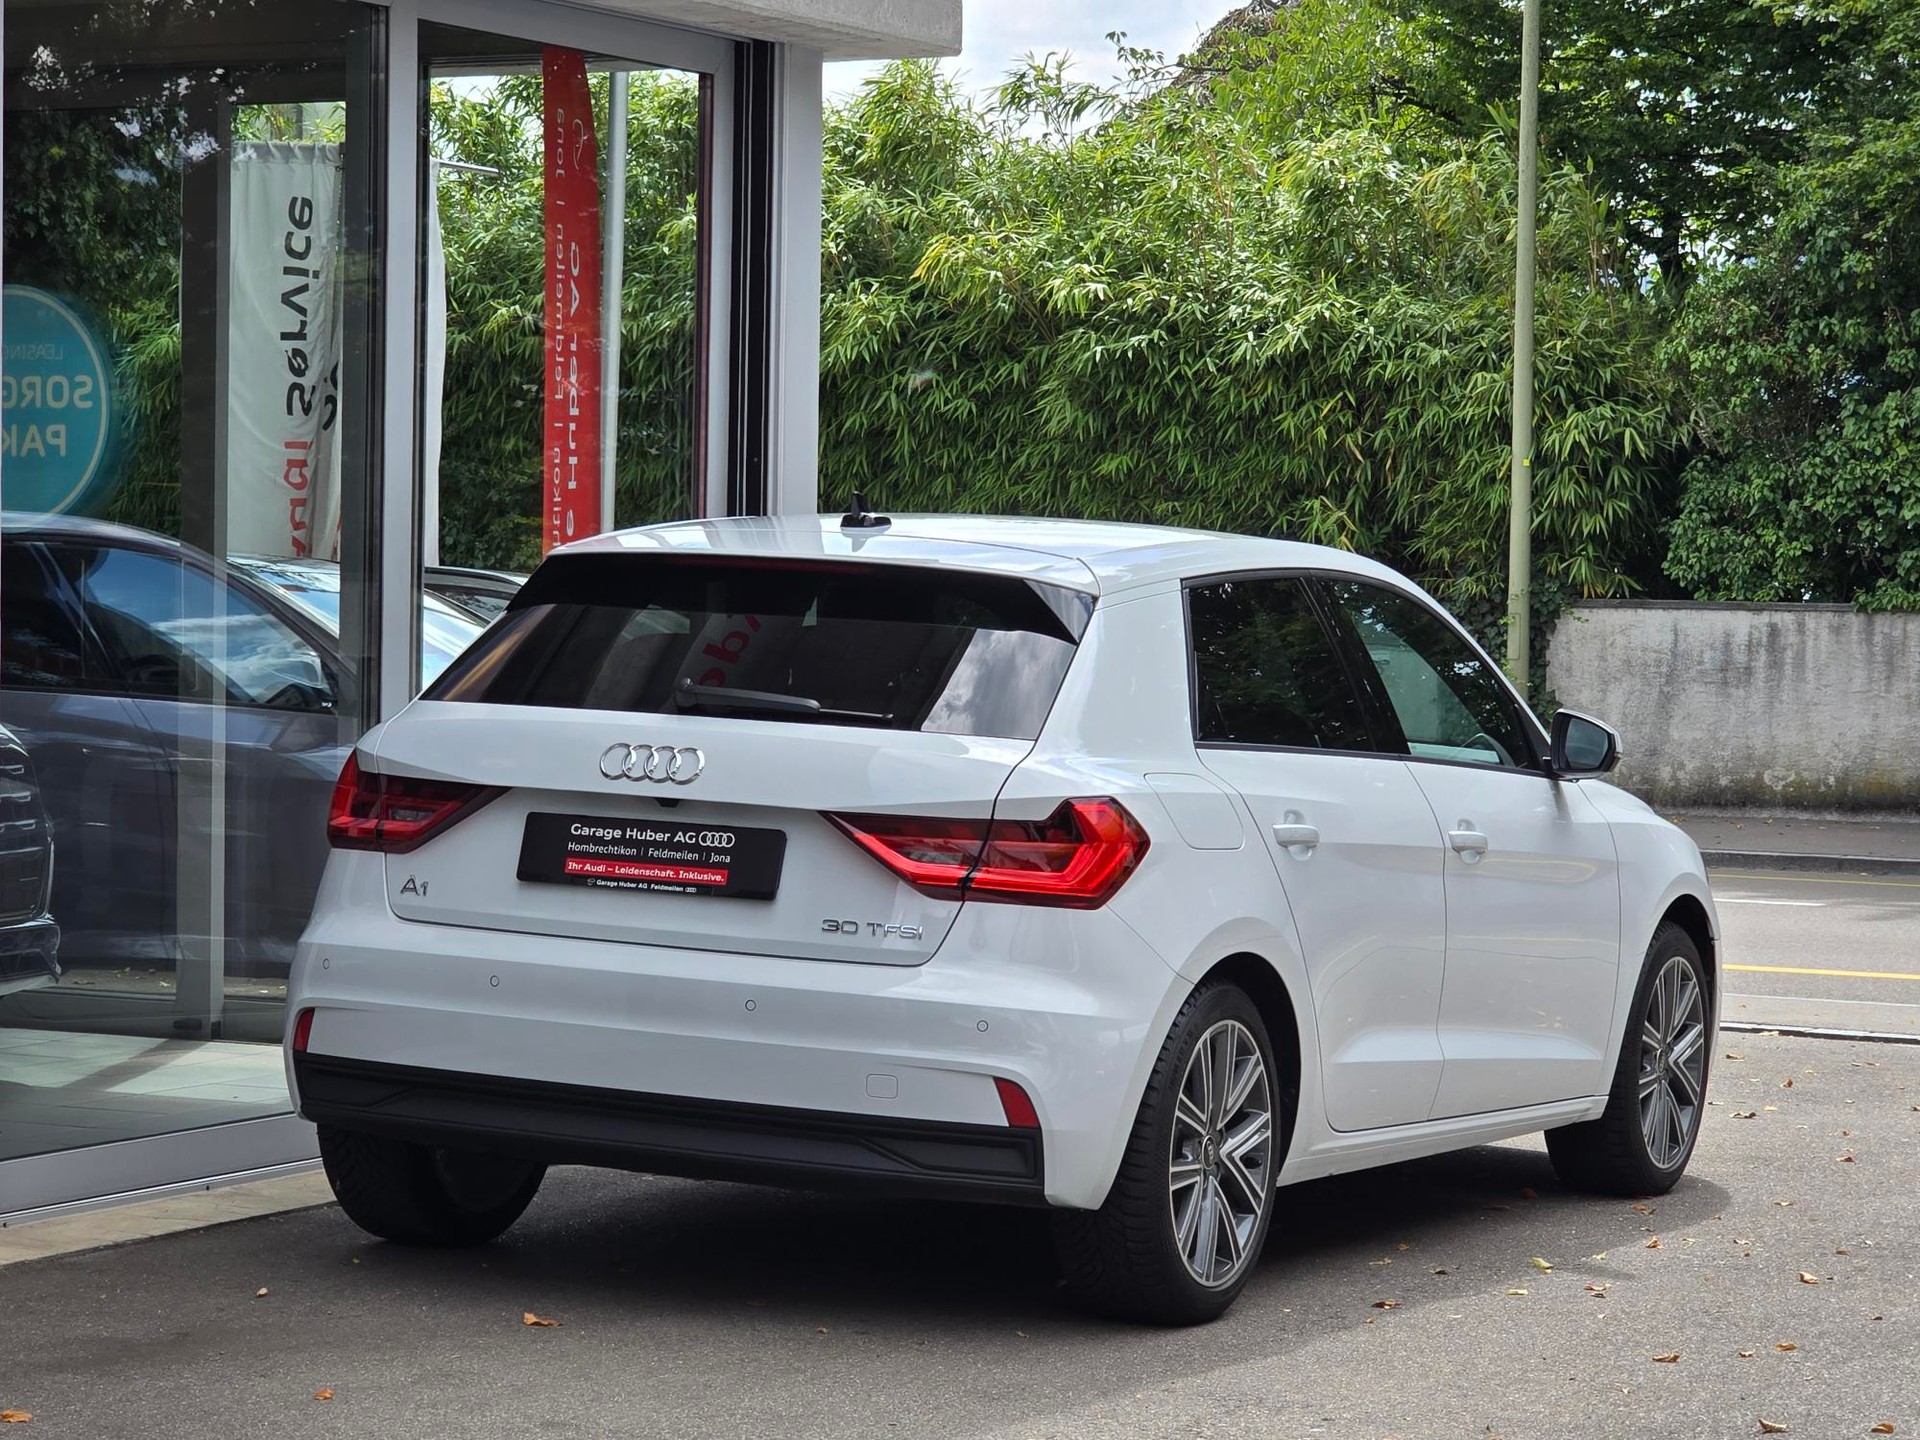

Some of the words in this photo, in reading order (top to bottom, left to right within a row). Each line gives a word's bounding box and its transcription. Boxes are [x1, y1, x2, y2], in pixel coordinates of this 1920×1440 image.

[571, 823, 622, 840] Garage
[626, 828, 670, 842] Huber
[674, 831, 696, 844] AG
[567, 841, 637, 856] Hombrechtikon
[648, 848, 699, 861] Feldmeilen
[709, 852, 731, 863] Jona
[568, 861, 583, 871] Ihr
[583, 863, 606, 873] Audi
[615, 865, 677, 879] Leidenschaft.
[679, 870, 725, 882] Inklusive.
[400, 875, 429, 897] A1
[596, 879, 618, 888] Garage
[619, 880, 637, 888] Huber
[821, 919, 858, 935] 30
[866, 922, 923, 941] TFSI
